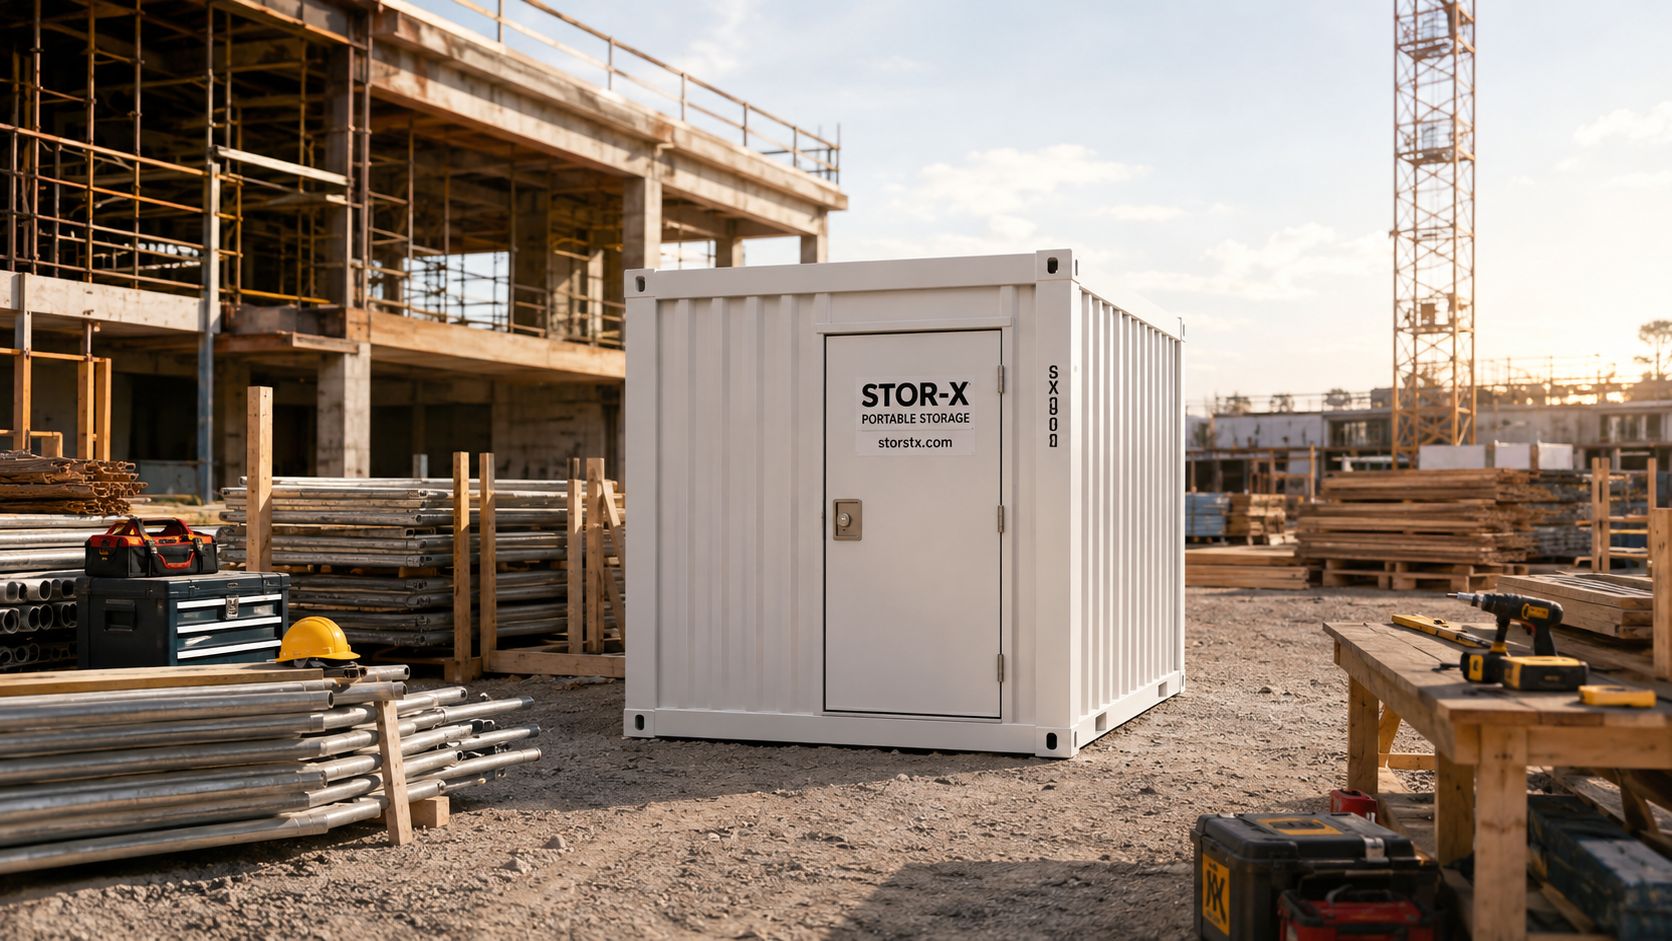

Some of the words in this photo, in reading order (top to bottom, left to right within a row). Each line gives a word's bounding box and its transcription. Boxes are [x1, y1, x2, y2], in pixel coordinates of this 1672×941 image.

[861, 380, 970, 408] STOR-X
[861, 413, 917, 425] PORTABLE
[919, 412, 970, 424] STORAGE
[878, 436, 953, 449] storstx.com
